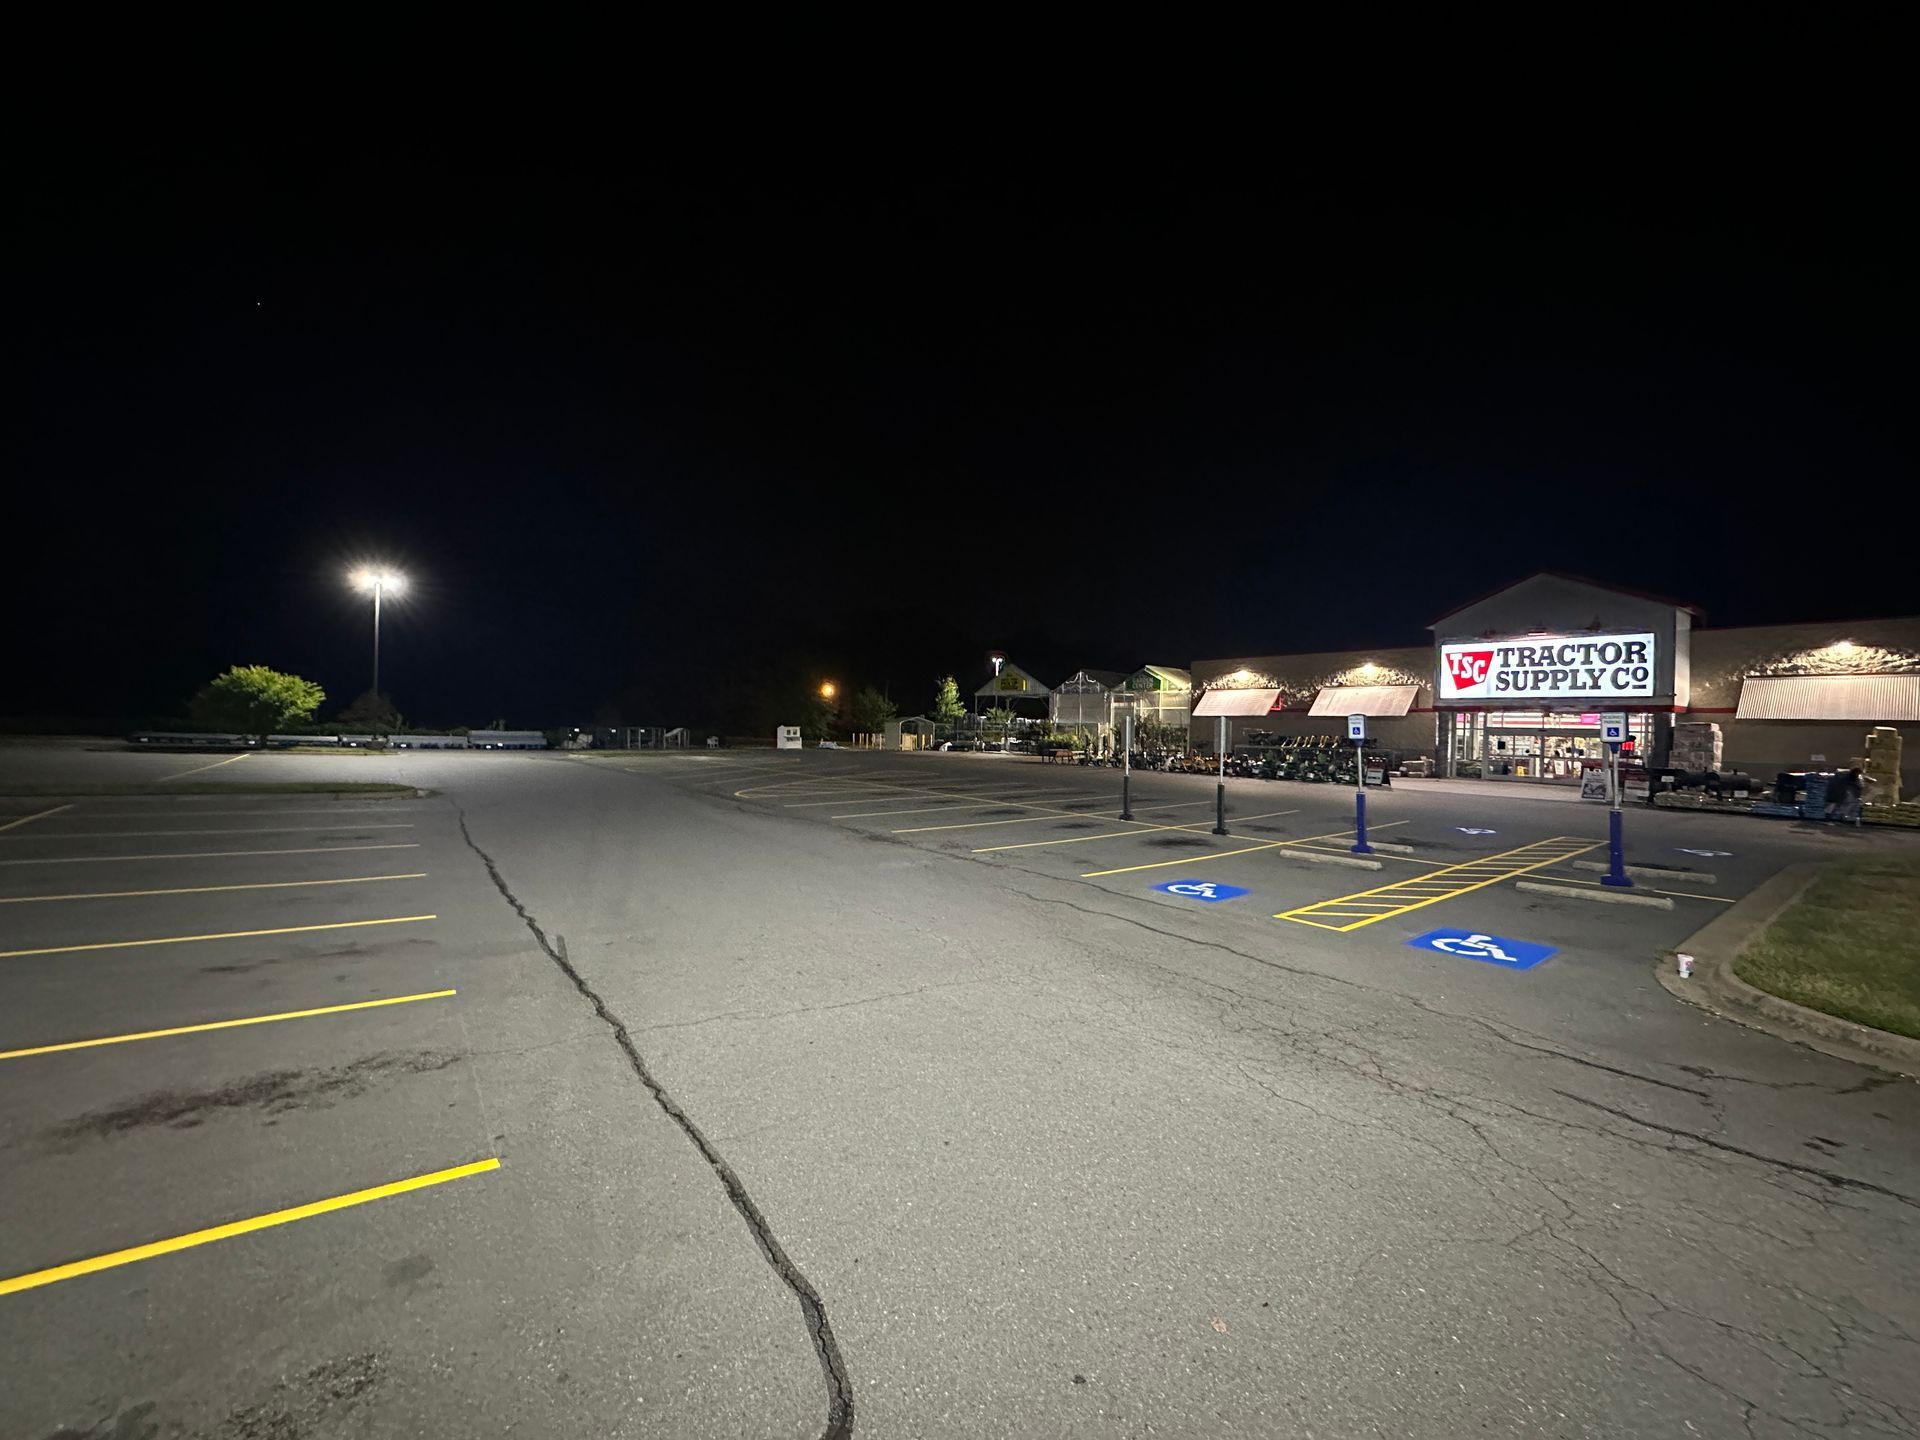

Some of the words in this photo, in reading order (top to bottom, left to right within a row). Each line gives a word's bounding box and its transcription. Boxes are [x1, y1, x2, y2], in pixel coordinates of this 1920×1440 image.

[1449, 653, 1486, 683] TSC
[1497, 641, 1648, 668] TRACTOR
[1495, 668, 1606, 691] SUPPLY
